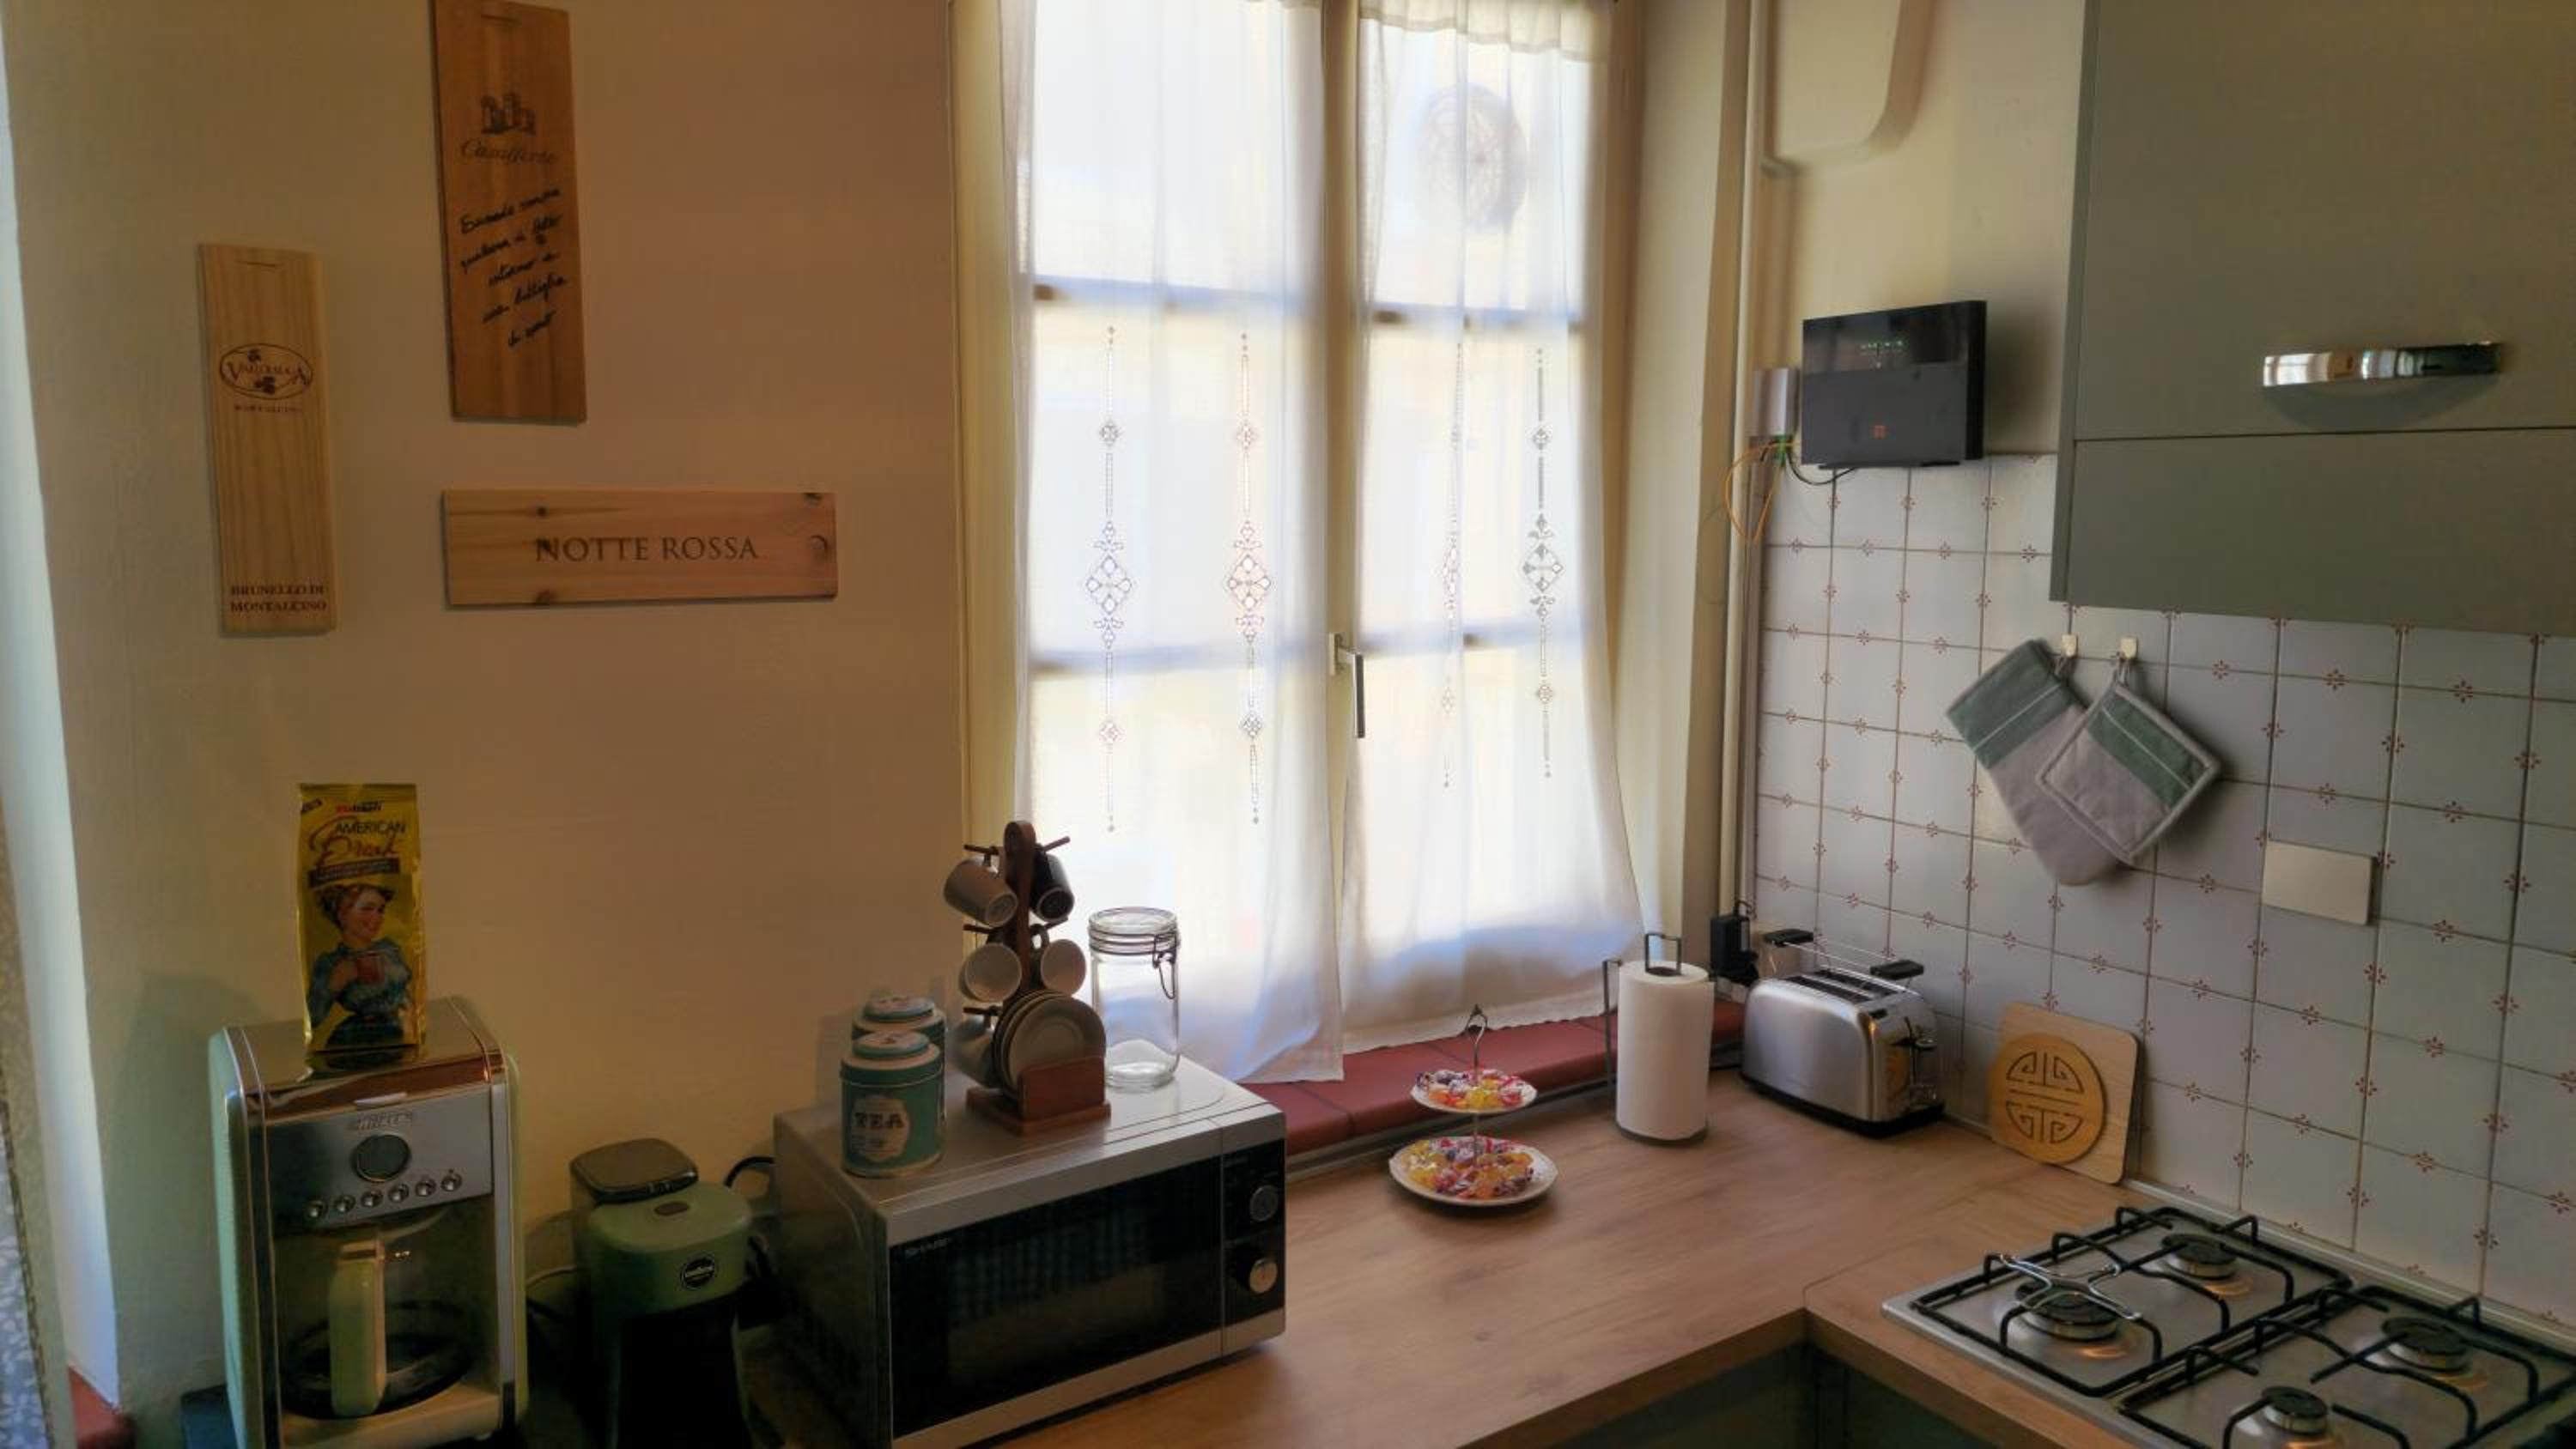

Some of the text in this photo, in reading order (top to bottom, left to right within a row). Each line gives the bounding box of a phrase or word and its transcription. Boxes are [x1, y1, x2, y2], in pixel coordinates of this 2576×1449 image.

[536, 536, 758, 561] NOTTE ROSSA
[230, 601, 326, 612] MONTALCINO
[333, 820, 407, 835] AMERICAN
[854, 1112, 905, 1130] TEA
